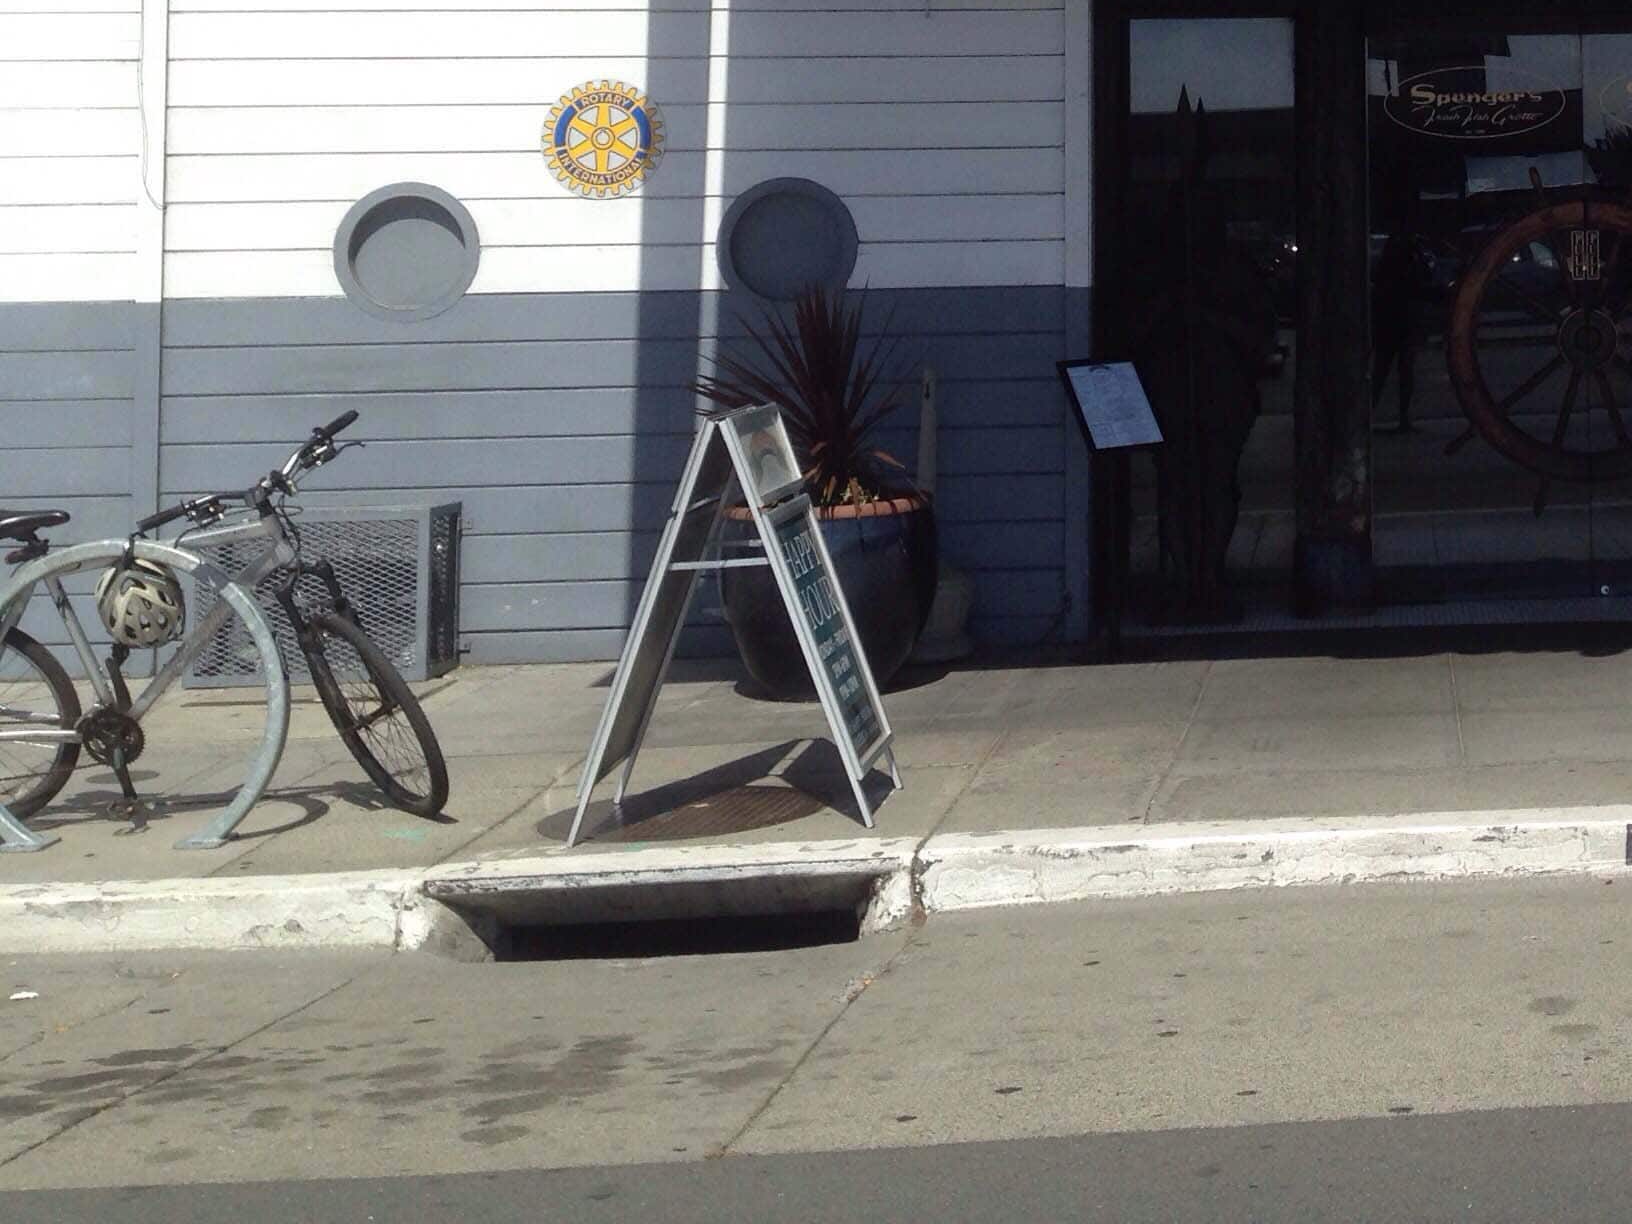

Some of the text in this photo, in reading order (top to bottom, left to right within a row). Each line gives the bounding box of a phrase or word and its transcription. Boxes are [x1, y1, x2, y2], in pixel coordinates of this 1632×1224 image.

[582, 92, 630, 108] ROTARY
[1409, 83, 1543, 107] Spenger's
[783, 530, 821, 580] HAPPY
[800, 575, 841, 630] HOUR
